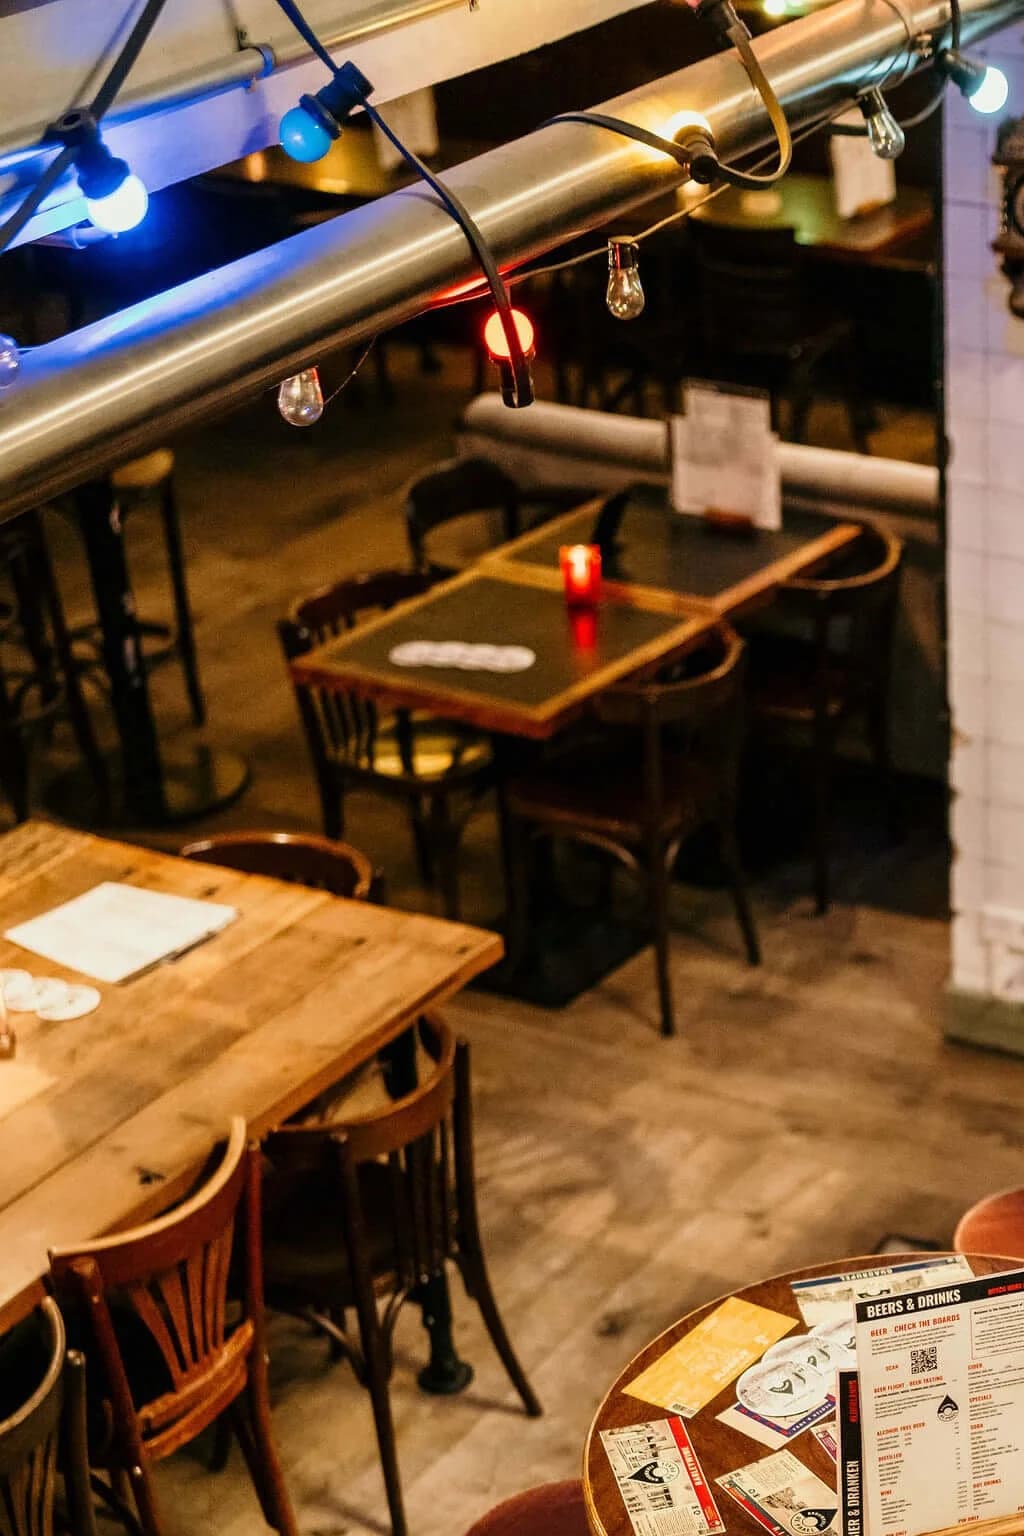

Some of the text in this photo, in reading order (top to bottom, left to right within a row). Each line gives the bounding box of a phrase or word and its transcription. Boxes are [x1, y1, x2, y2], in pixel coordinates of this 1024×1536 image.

[867, 1289, 961, 1318] BEERS & DRINKS
[870, 1314, 961, 1337] BEER CHECK THE BOARDS
[847, 1460, 860, 1506] DRANKEN
[848, 1507, 860, 1516] &
